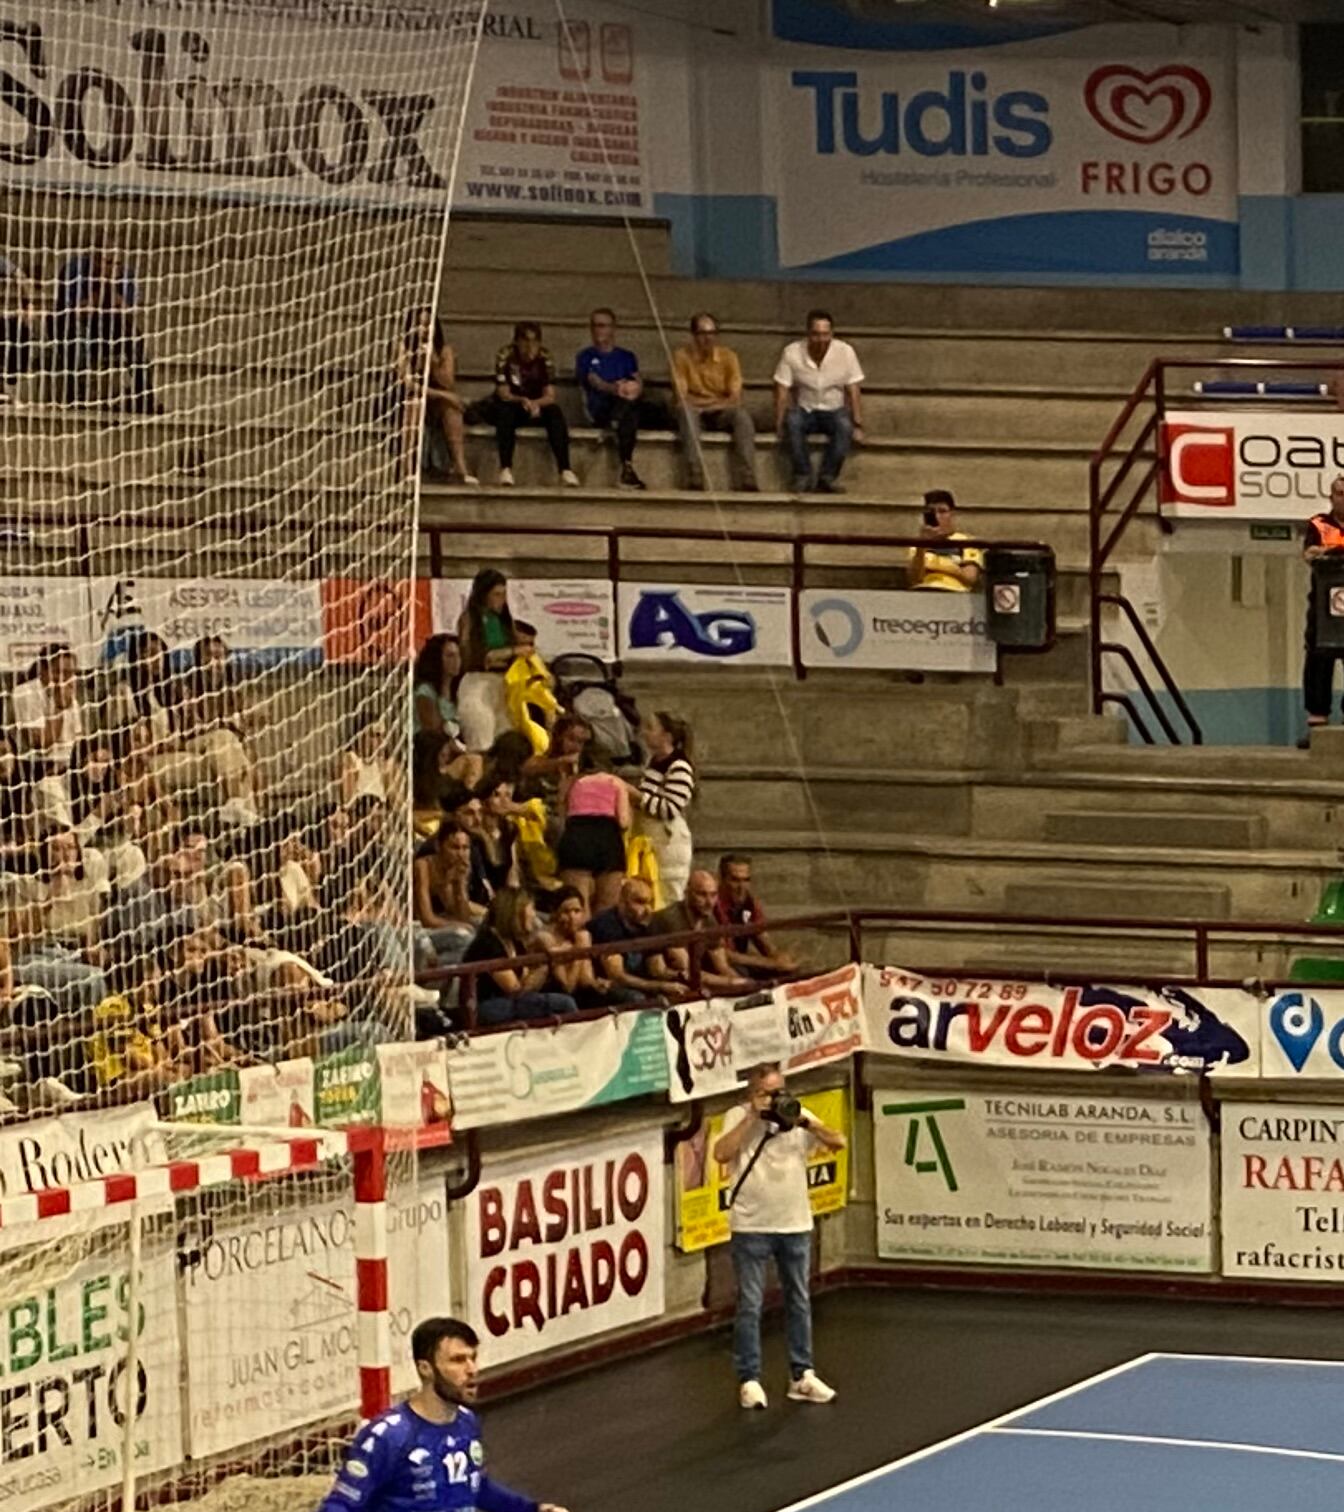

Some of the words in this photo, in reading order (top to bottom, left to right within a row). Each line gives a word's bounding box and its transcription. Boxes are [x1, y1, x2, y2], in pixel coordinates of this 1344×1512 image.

[791, 70, 1053, 158] Tudis
[1081, 161, 1213, 196] FRIGO
[964, 981, 993, 999] 72
[888, 986, 1173, 1062] arveloz
[984, 1099, 1069, 1119] TECNILAB
[1075, 1129, 1098, 1144] DE
[1103, 1131, 1196, 1148] EMPRESAS
[478, 1151, 649, 1258] BASILIO
[908, 1211, 961, 1229] expertos
[965, 1214, 981, 1228] en
[984, 1212, 1036, 1233] Derecho
[1039, 1214, 1087, 1235] Laboral
[1100, 1218, 1162, 1240] Seguridad
[1166, 1221, 1205, 1239] Social
[184, 1208, 355, 1287] PORCELANO
[482, 1228, 649, 1338] CRIADO
[0, 1268, 146, 1377] BLES
[228, 1347, 280, 1389] JUAN
[442, 1450, 468, 1484] 12
